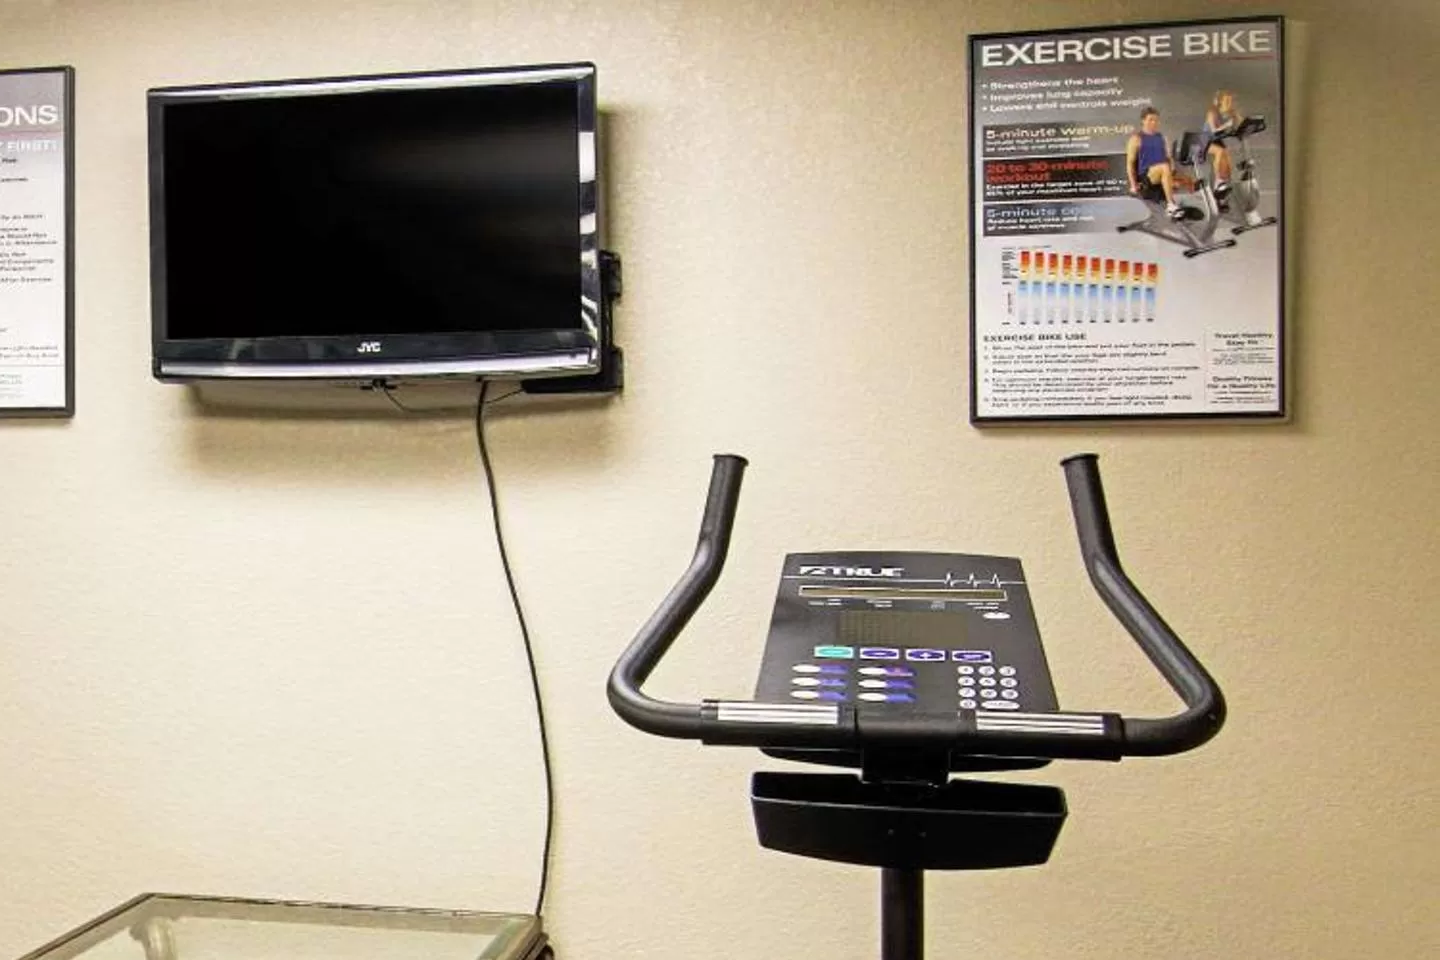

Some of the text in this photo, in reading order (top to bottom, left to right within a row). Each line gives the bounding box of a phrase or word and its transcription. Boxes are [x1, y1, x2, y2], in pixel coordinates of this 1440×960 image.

[982, 30, 1272, 69] EXERCISE BIKE
[990, 76, 1118, 90] Strengthens the heart
[990, 92, 1043, 102] Improves
[986, 123, 1136, 139] 5-minute warm-up
[987, 207, 1057, 218] 5-minute
[357, 341, 381, 352] JVC
[825, 566, 905, 577] TRUE
